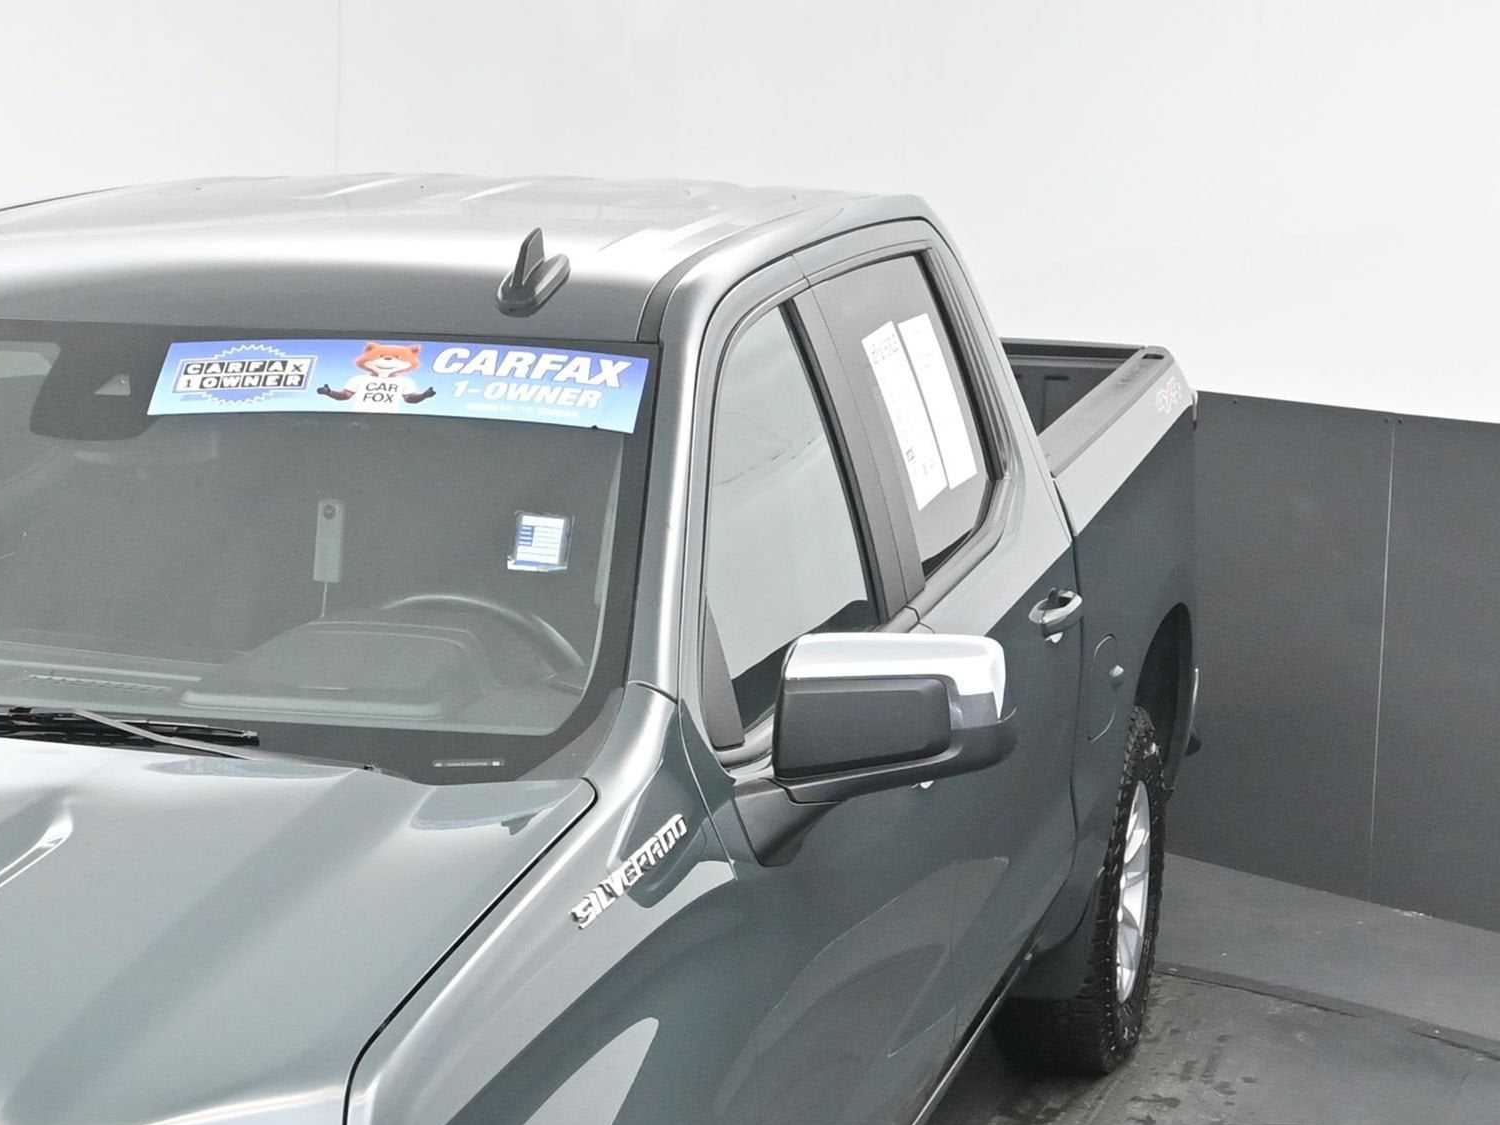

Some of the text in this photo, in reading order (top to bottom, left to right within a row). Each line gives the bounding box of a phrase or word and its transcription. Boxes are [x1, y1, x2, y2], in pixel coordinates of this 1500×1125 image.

[185, 361, 303, 375] CARFAX
[431, 347, 632, 388] CARFAX
[200, 375, 303, 389] OWNER
[365, 382, 399, 393] CAR
[362, 392, 395, 403] FOX
[452, 380, 603, 409] 1-OWNER
[568, 813, 688, 930] SILVERADO
